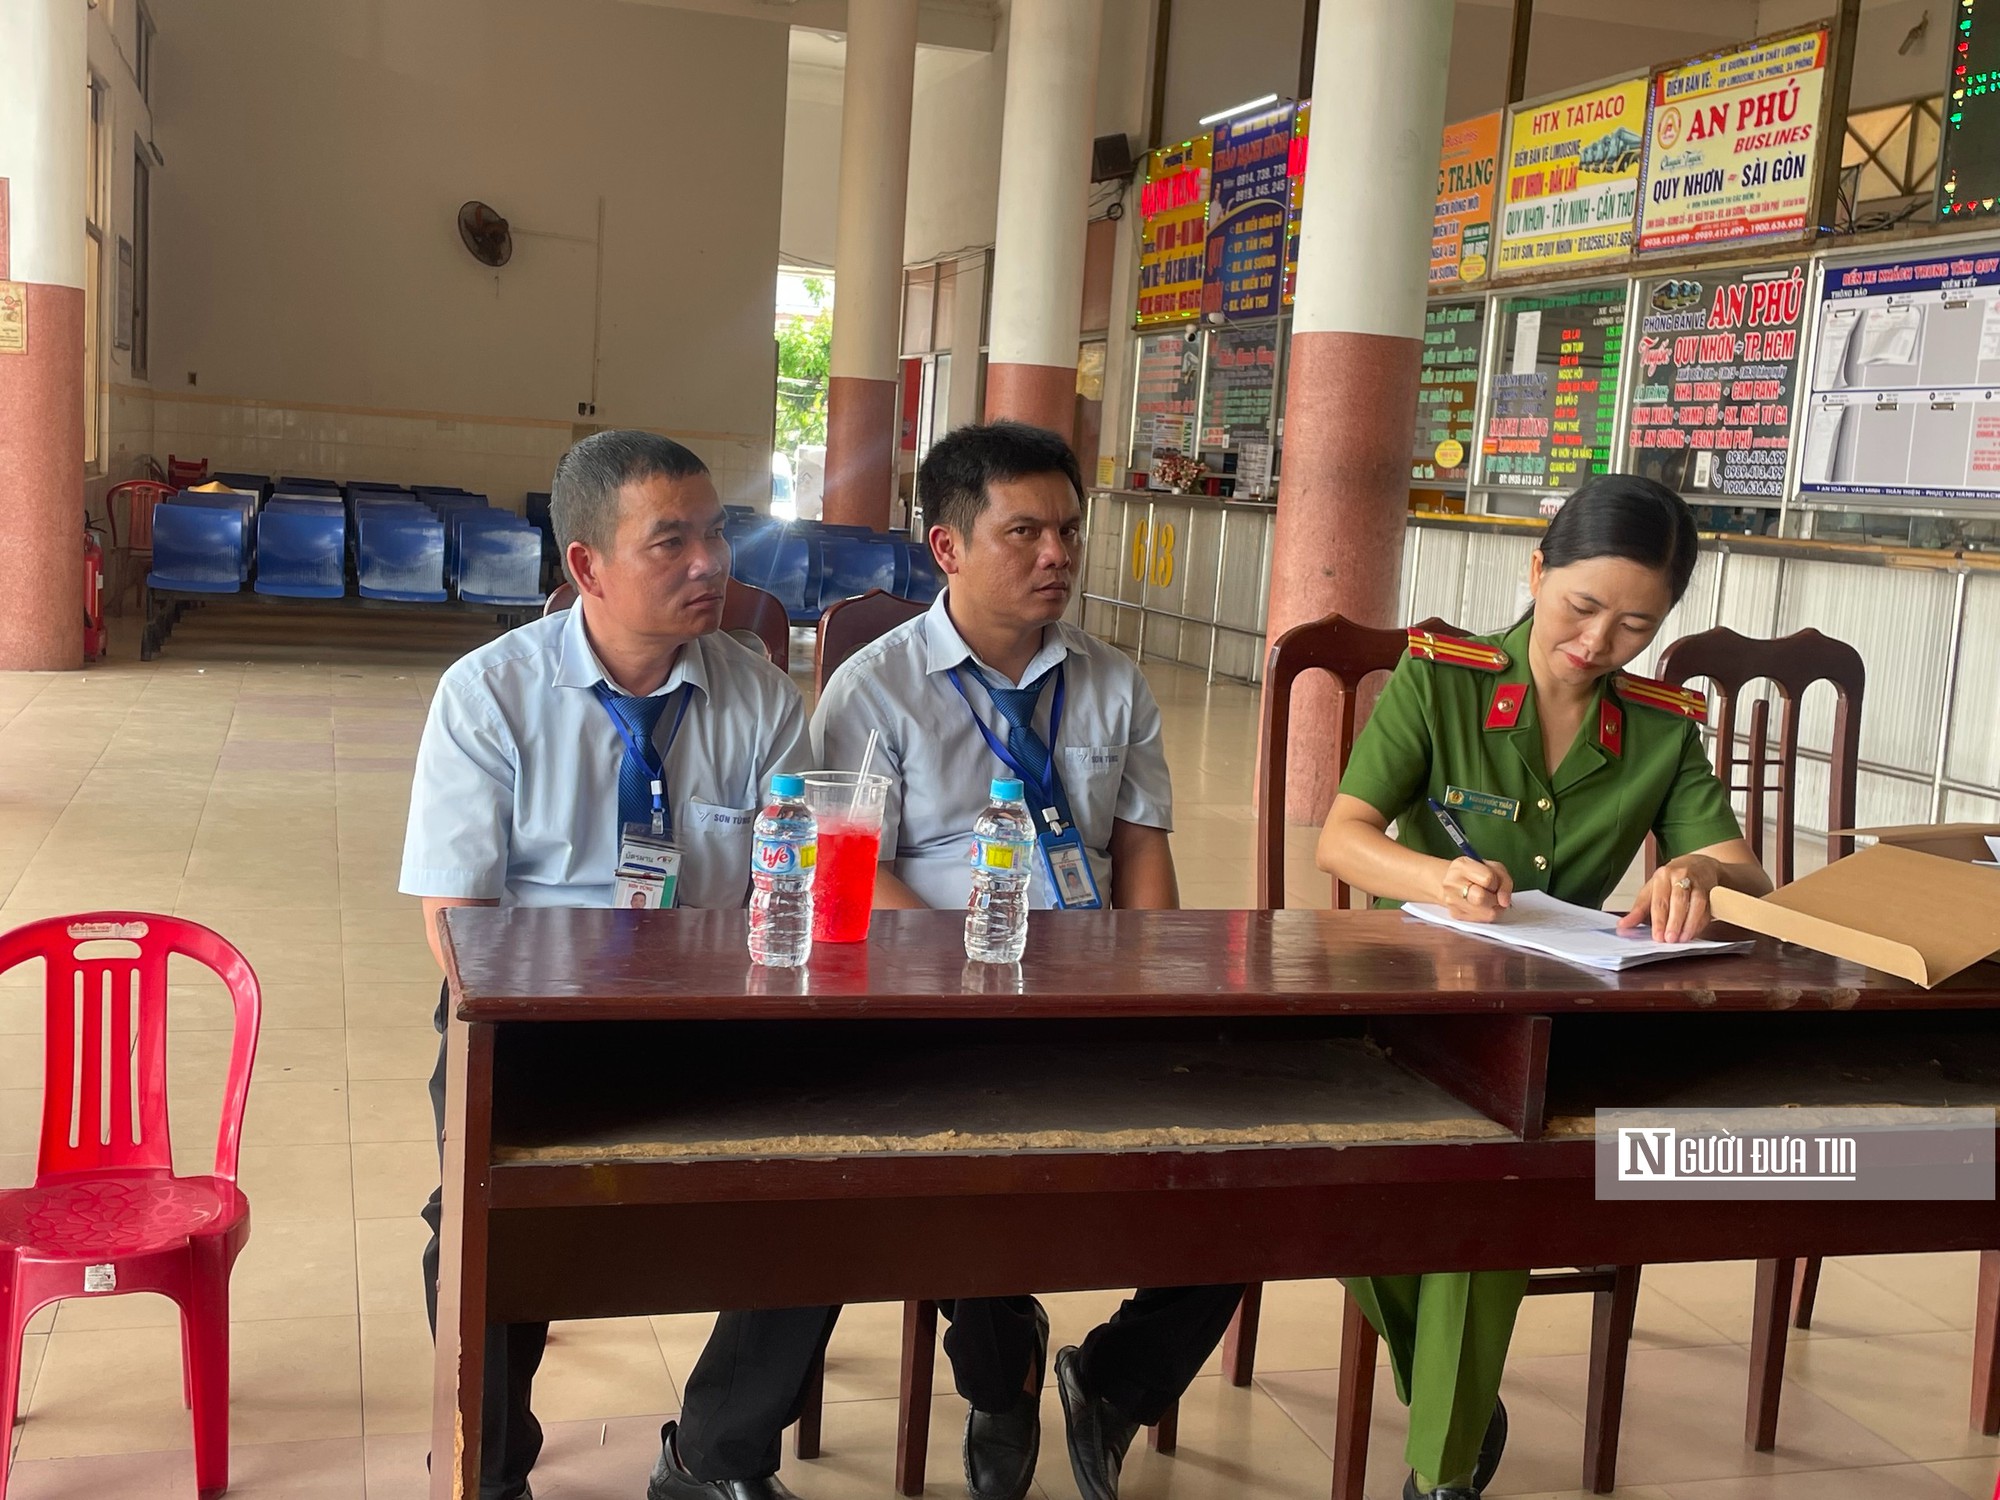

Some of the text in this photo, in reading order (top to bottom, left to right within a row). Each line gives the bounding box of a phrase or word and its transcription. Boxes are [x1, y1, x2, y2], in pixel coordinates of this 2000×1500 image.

[1533, 95, 1625, 135] HTX TATACO
[1686, 78, 1801, 142] AN PHÚ
[1733, 124, 1813, 154] BUSLINES
[1448, 158, 1493, 194] TRANG
[1653, 151, 1806, 205] QUY NHƠN SÀI GÒN
[1506, 187, 1636, 235] QUY NHƠN TÂY NINH CẦN THƠ
[1751, 217, 1804, 233] 1900.636.632
[1842, 257, 1999, 286] BẾN XE KHÁCH TRUNG TÂM QUY
[1708, 266, 1804, 329] AN PHÚ
[1643, 313, 1672, 333] PHÒNG
[1673, 310, 1692, 331] BÁN
[1694, 308, 1706, 330] VÉ
[1674, 330, 1796, 366] QUY NHƠN TP. HCM
[1674, 383, 1692, 401] NHA
[1693, 382, 1721, 401] TRANG
[1731, 381, 1753, 400] CAM
[1753, 380, 1780, 400] RANH
[1774, 406, 1788, 425] GA
[1643, 430, 1656, 448] AN
[1656, 428, 1685, 448] SƯƠNG
[1690, 430, 1714, 448] AEON
[1715, 427, 1733, 449] TÂN
[1733, 427, 1753, 449] PHÚ
[1726, 451, 1786, 464] 0938.413.699
[1724, 465, 1785, 479] 0989.413.499
[1723, 481, 1783, 495] 1900.636.632
[714, 813, 751, 825] SƠN TÙNG
